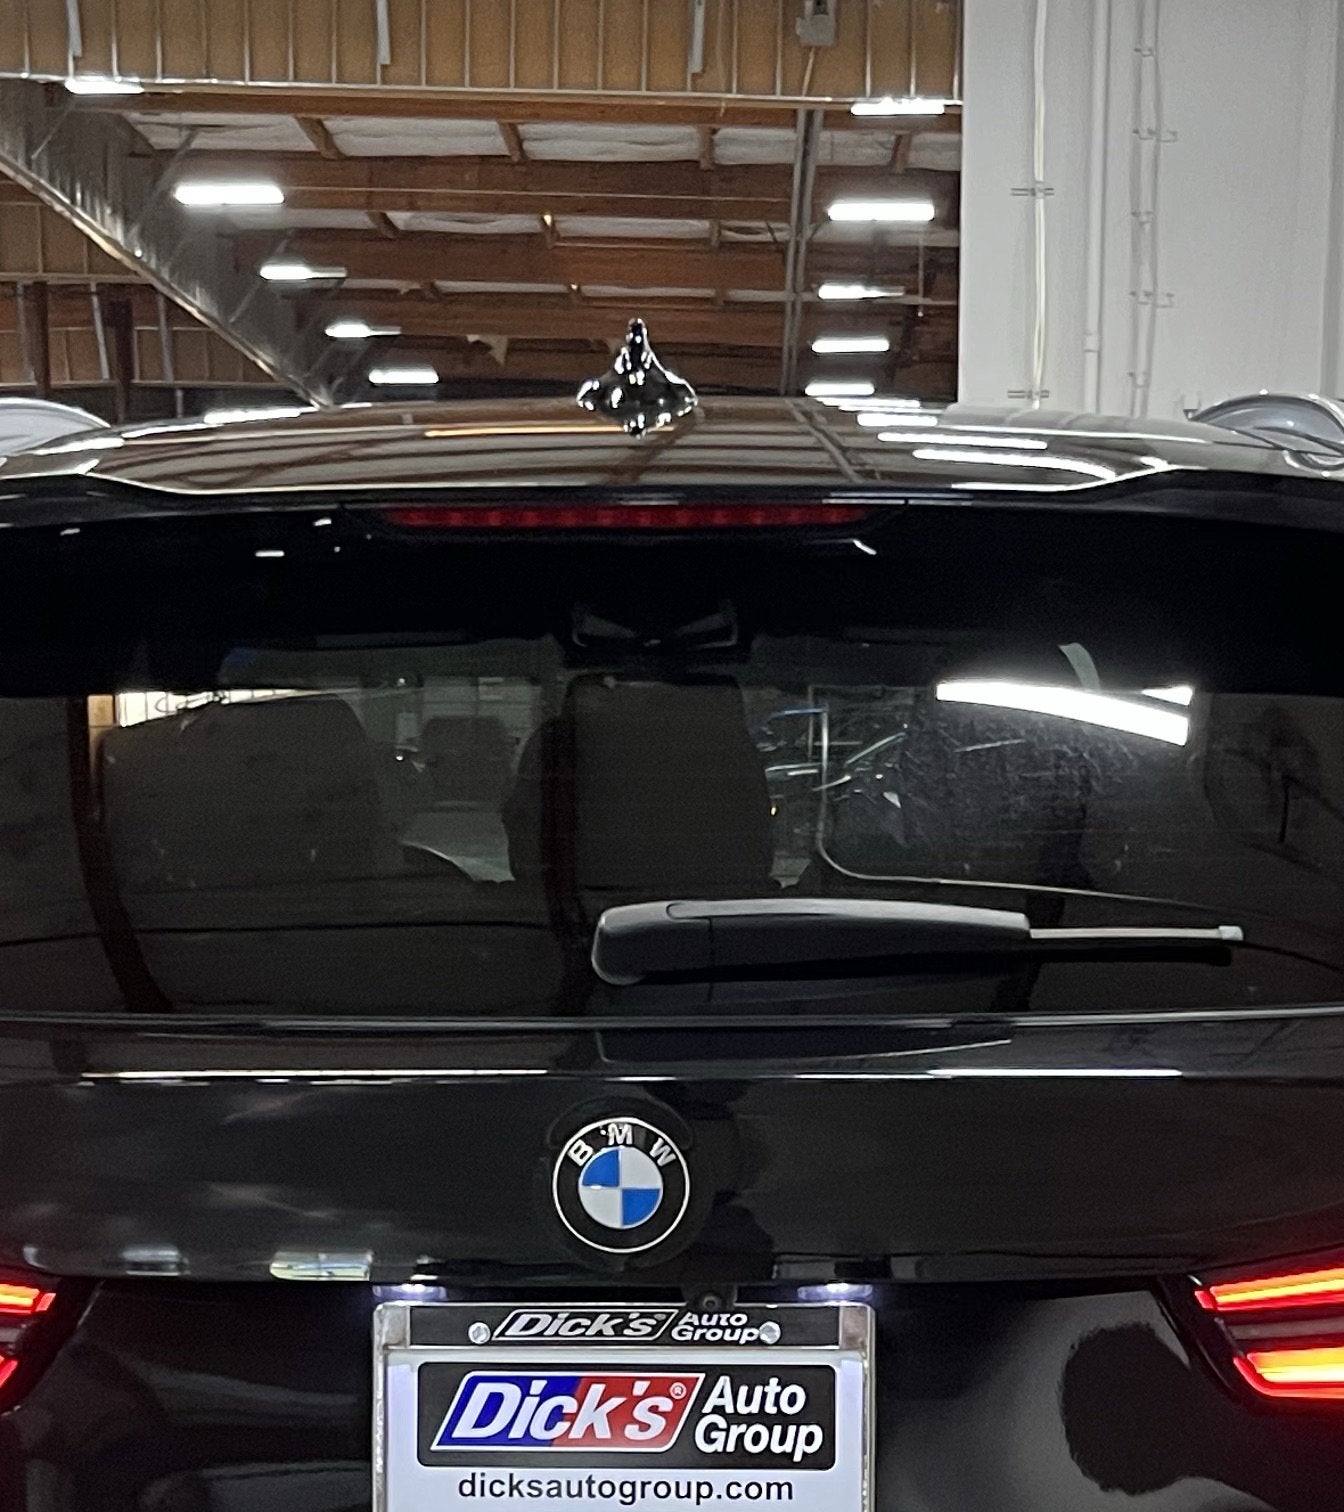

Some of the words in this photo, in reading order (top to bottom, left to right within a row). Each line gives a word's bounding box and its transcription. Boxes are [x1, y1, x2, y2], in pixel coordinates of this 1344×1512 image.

[567, 1122, 677, 1167] BMW
[671, 1324, 760, 1345] Group
[678, 1311, 748, 1327] Auto
[702, 1375, 807, 1415] Auto
[694, 1413, 824, 1462] Group
[458, 1473, 793, 1504] dicksautogroup.com
